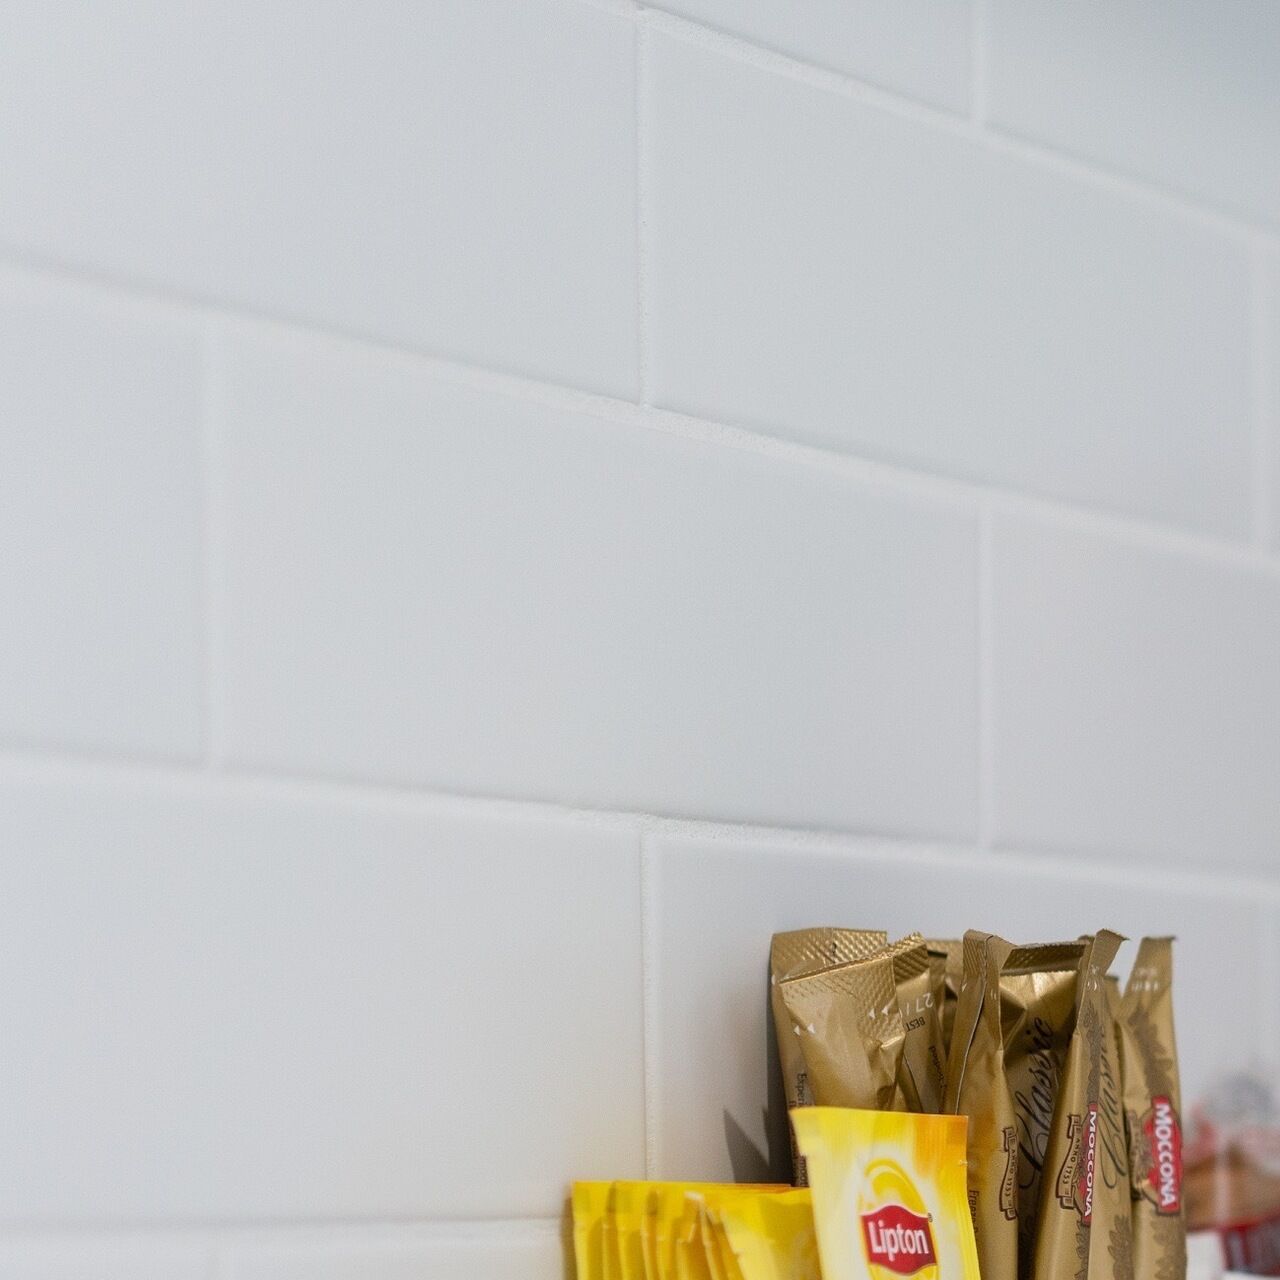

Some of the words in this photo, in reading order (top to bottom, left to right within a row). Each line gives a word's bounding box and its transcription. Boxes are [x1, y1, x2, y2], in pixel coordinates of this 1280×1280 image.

[1083, 1110, 1097, 1217] MOCCONA
[1154, 1103, 1176, 1207] MOCCONA
[868, 1219, 929, 1262] Lipton
